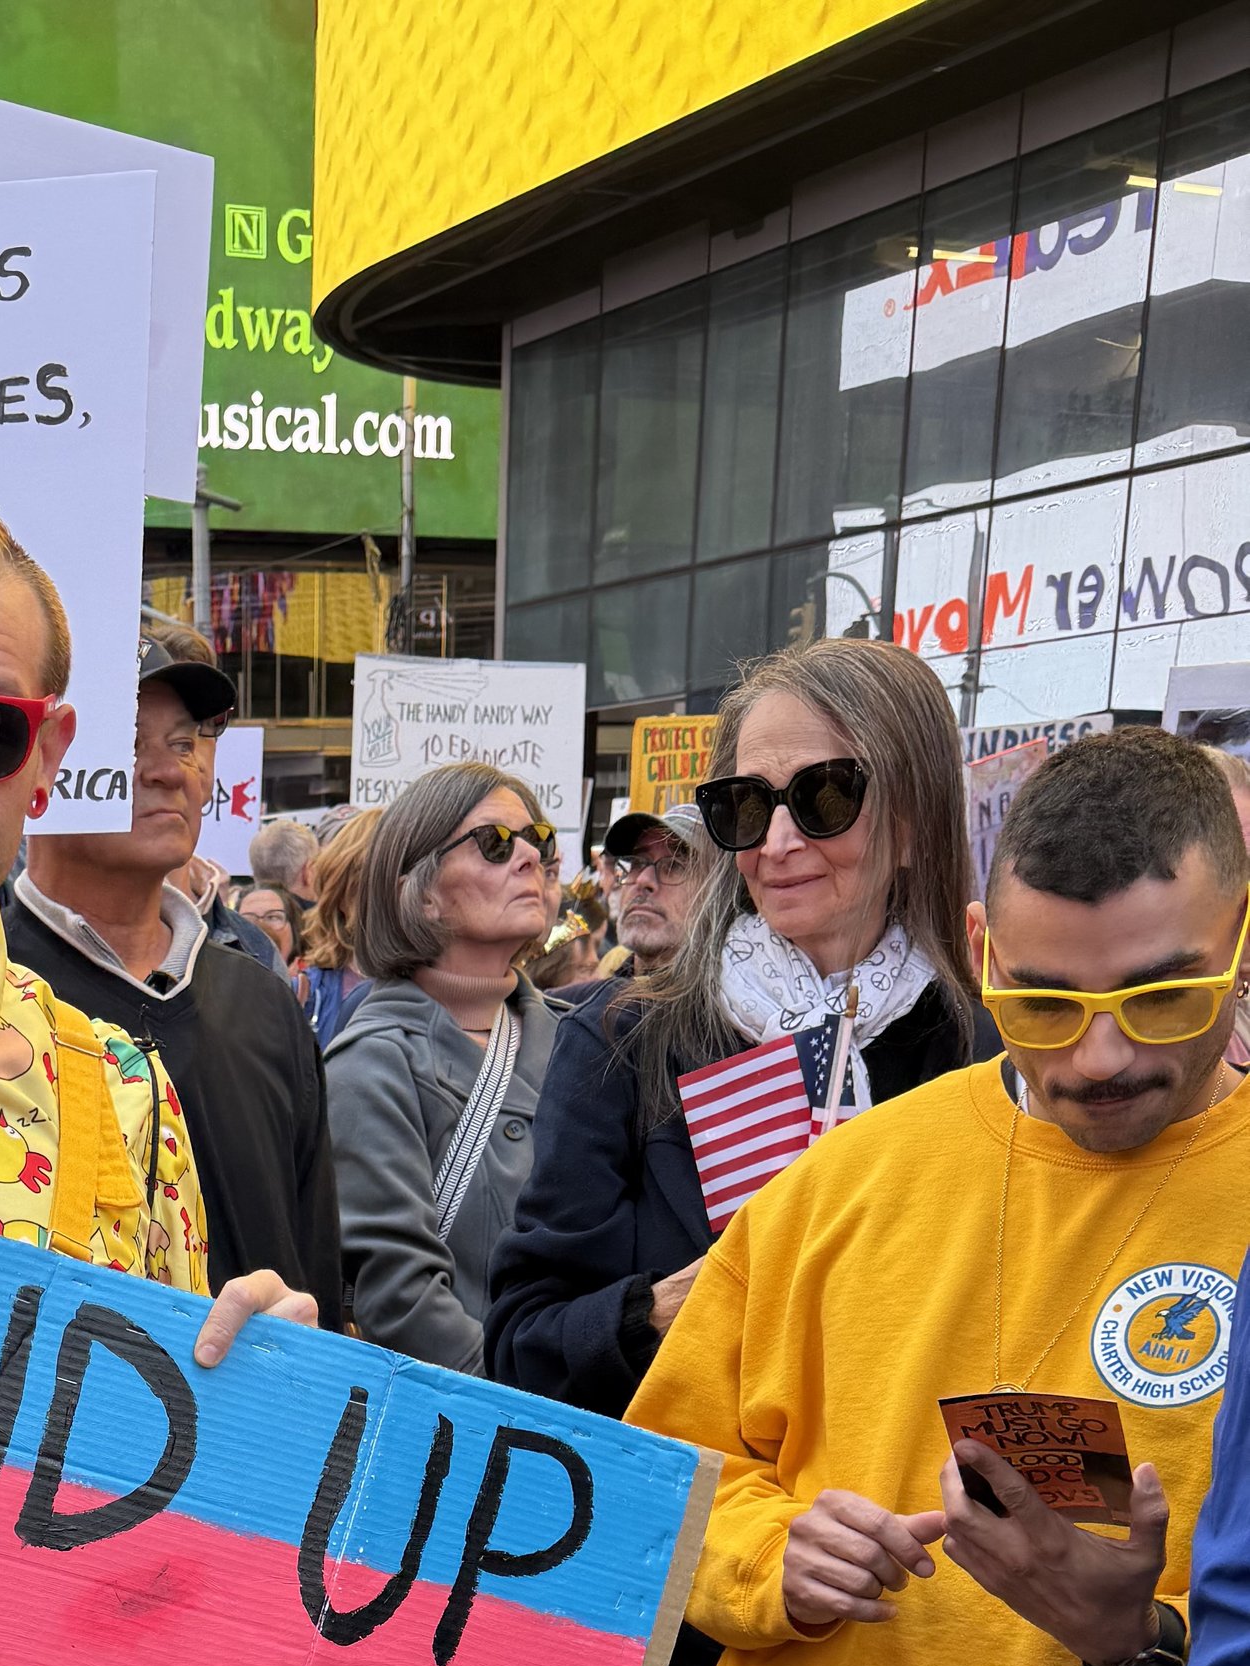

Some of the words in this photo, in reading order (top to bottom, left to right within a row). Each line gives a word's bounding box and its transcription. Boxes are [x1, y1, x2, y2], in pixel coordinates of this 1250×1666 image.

[397, 702, 423, 723] THE
[425, 703, 468, 724] HANDY
[473, 704, 518, 725] DANDY
[521, 705, 553, 725] WAY
[643, 726, 697, 754] PROTECT
[1125, 1269, 1173, 1300] NEW
[1100, 1319, 1133, 1386] CHARTER
[1131, 1378, 1174, 1399] HIGH
[1179, 1350, 1230, 1396] SCHOO
[1138, 1340, 1174, 1361] AIM
[973, 1401, 1080, 1420] TRUMP
[960, 1415, 1050, 1439] MUST
[1056, 1415, 1109, 1434] GO
